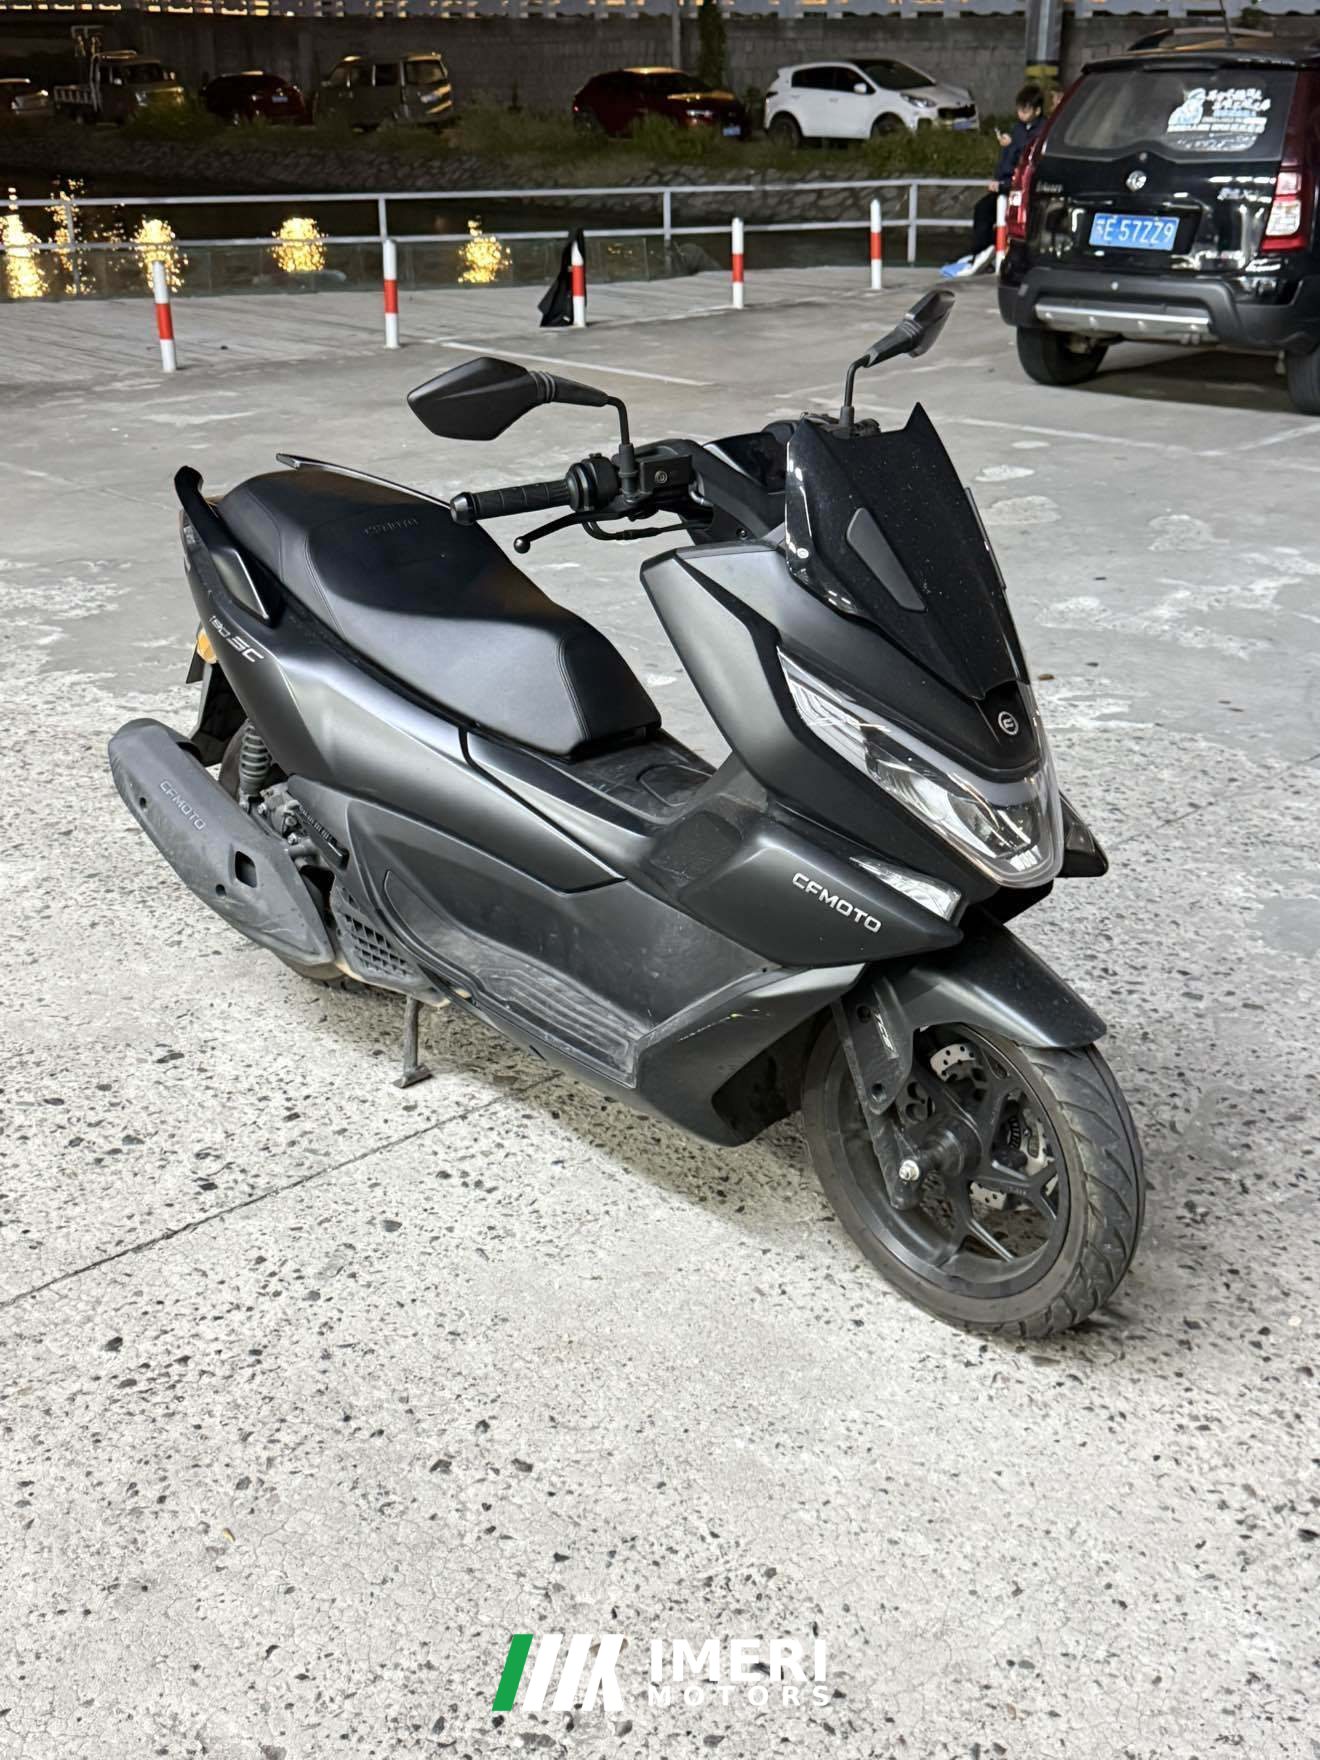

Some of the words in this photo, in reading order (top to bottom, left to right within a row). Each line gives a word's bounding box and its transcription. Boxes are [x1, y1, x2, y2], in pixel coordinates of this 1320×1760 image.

[1118, 219, 1173, 243] 57ZZ9
[160, 780, 206, 831] CFMOTO
[792, 872, 882, 933] CFMOTO
